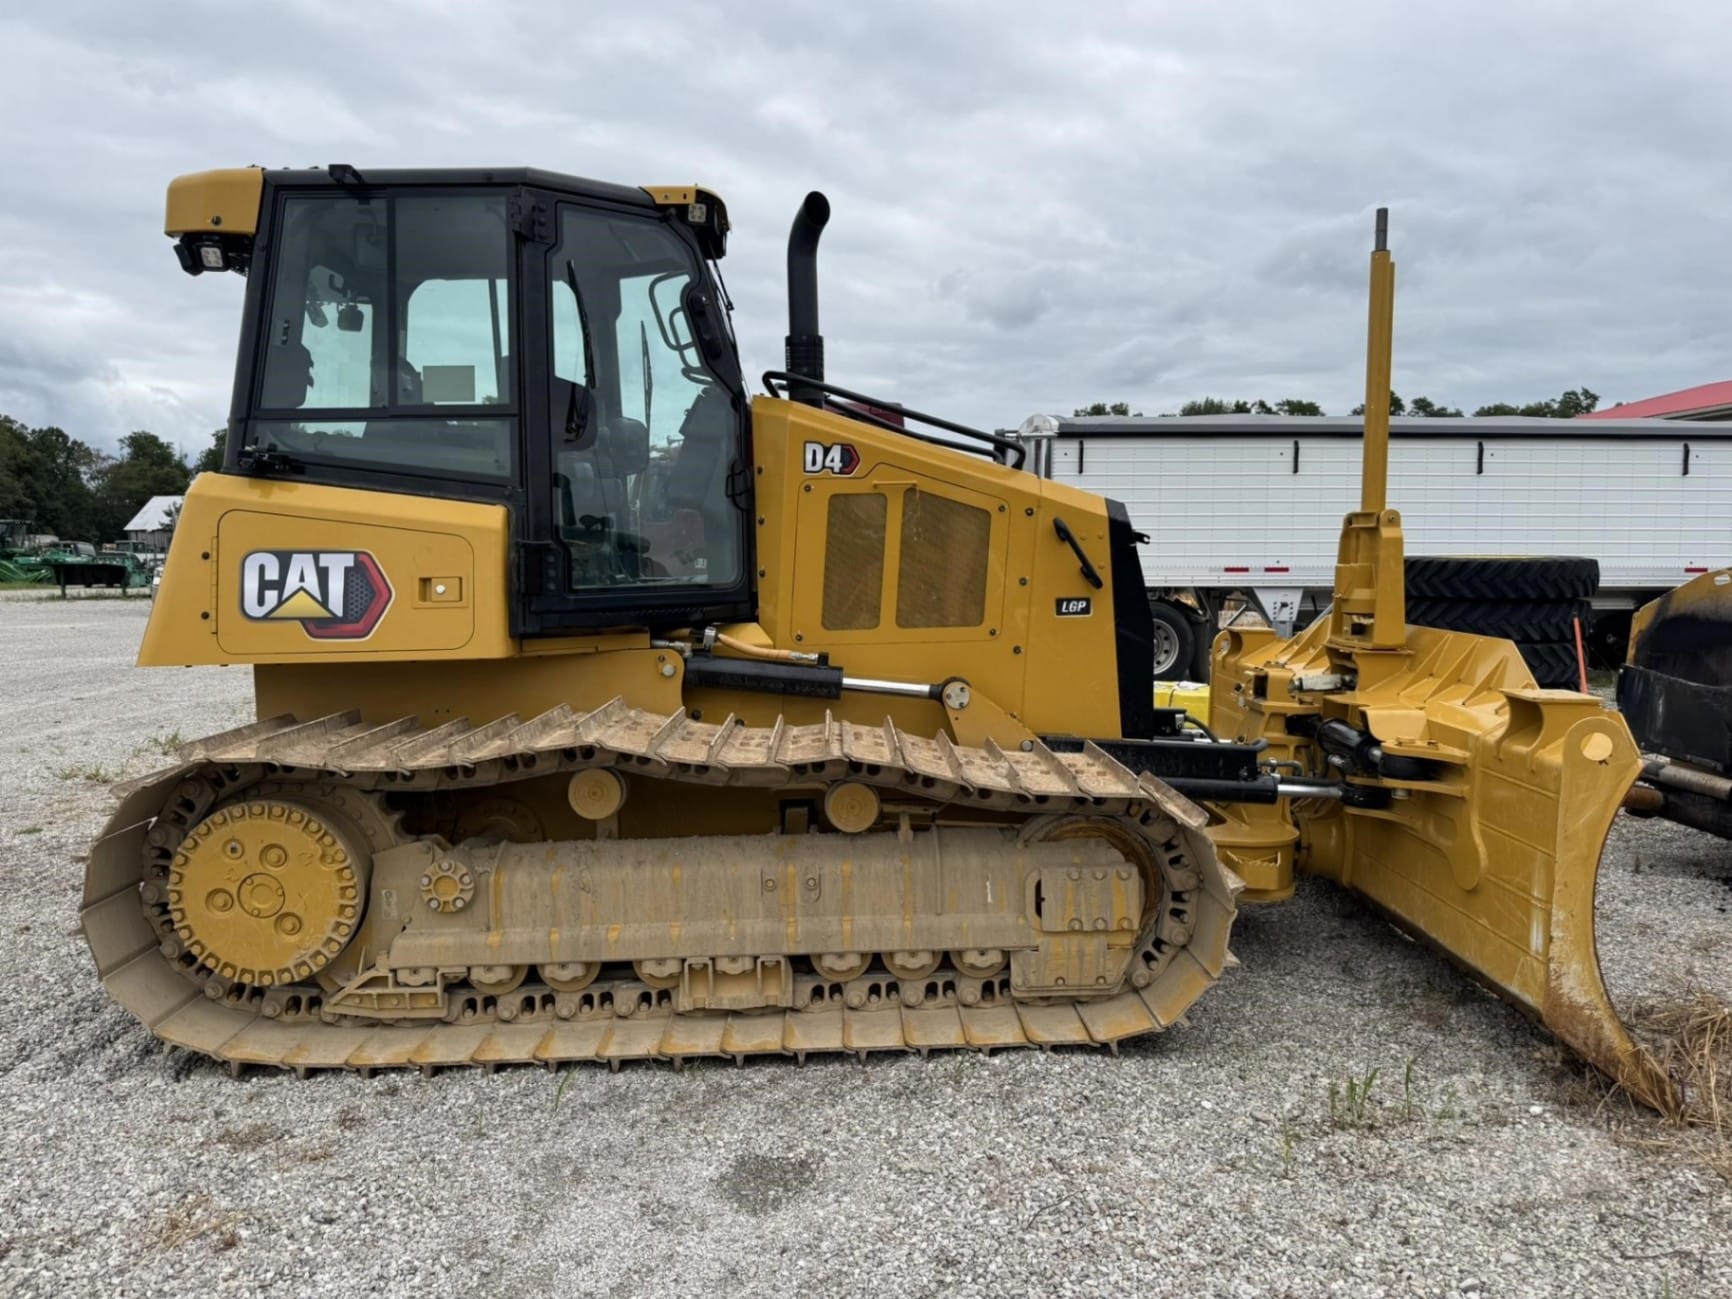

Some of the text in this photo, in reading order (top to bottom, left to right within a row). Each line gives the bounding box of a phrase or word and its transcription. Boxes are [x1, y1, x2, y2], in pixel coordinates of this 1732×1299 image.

[805, 442, 842, 473] D4
[243, 552, 355, 618] CAT
[1061, 600, 1087, 613] LGP
